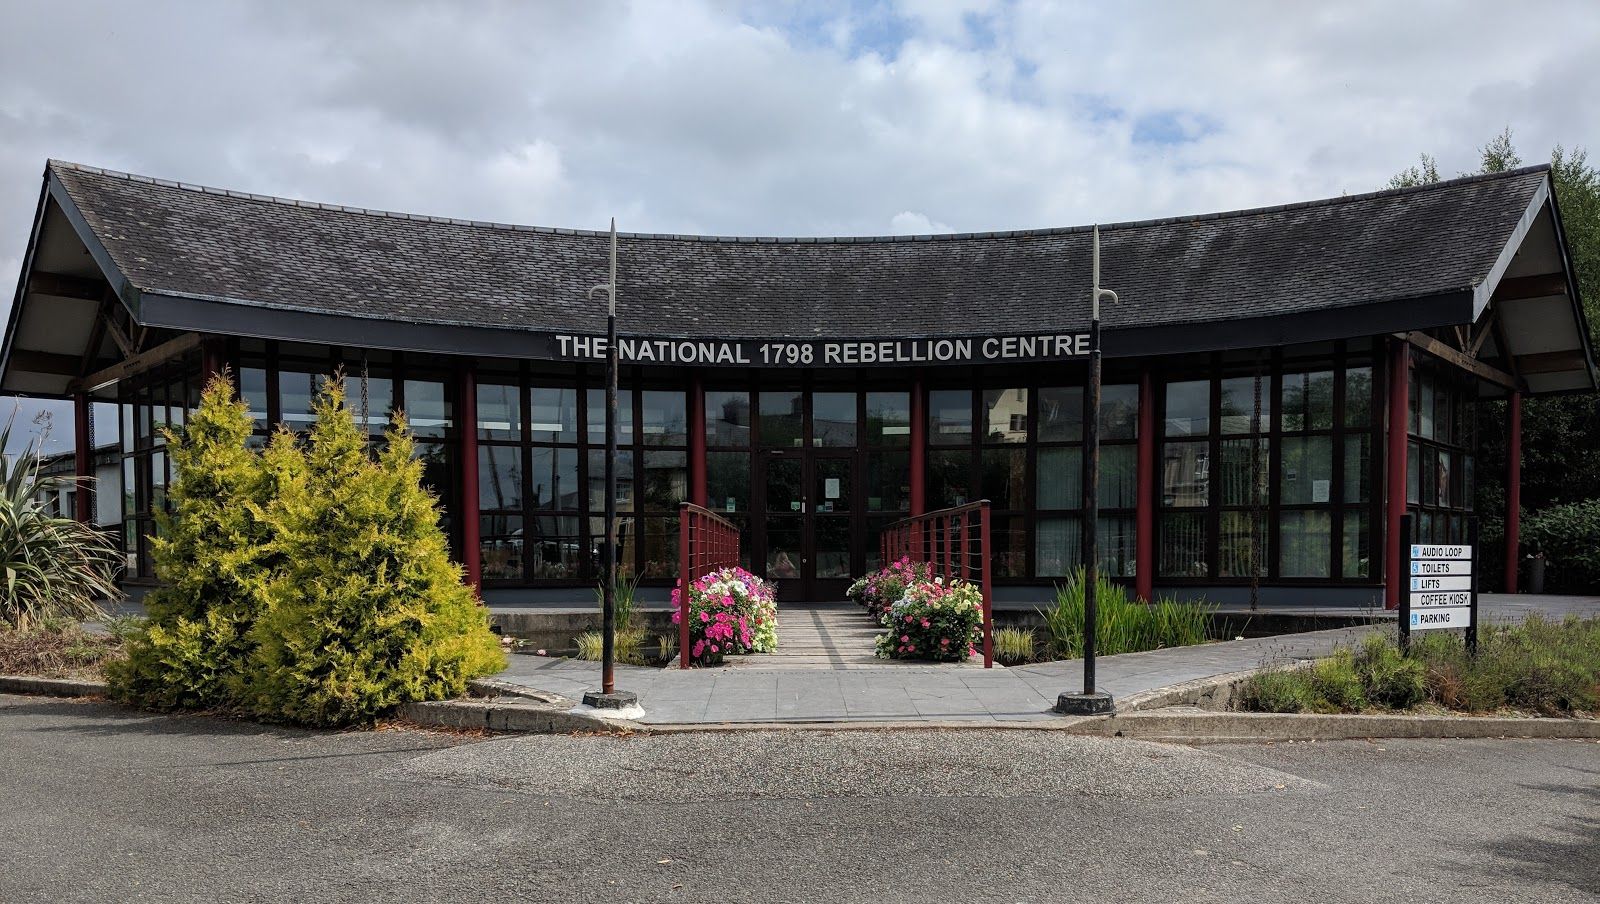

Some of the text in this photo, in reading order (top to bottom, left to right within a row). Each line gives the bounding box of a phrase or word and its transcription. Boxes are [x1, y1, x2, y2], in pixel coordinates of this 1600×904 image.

[555, 334, 1091, 364] THE NATIONAL 1798 REBELLION CENTRE
[1422, 547, 1463, 557] AUDIO LOOP
[1422, 563, 1450, 573] TOILETS
[1421, 579, 1440, 589] LIFTS
[1420, 593, 1469, 606] COFFEE KIOSK
[1420, 613, 1450, 624] PARKING
